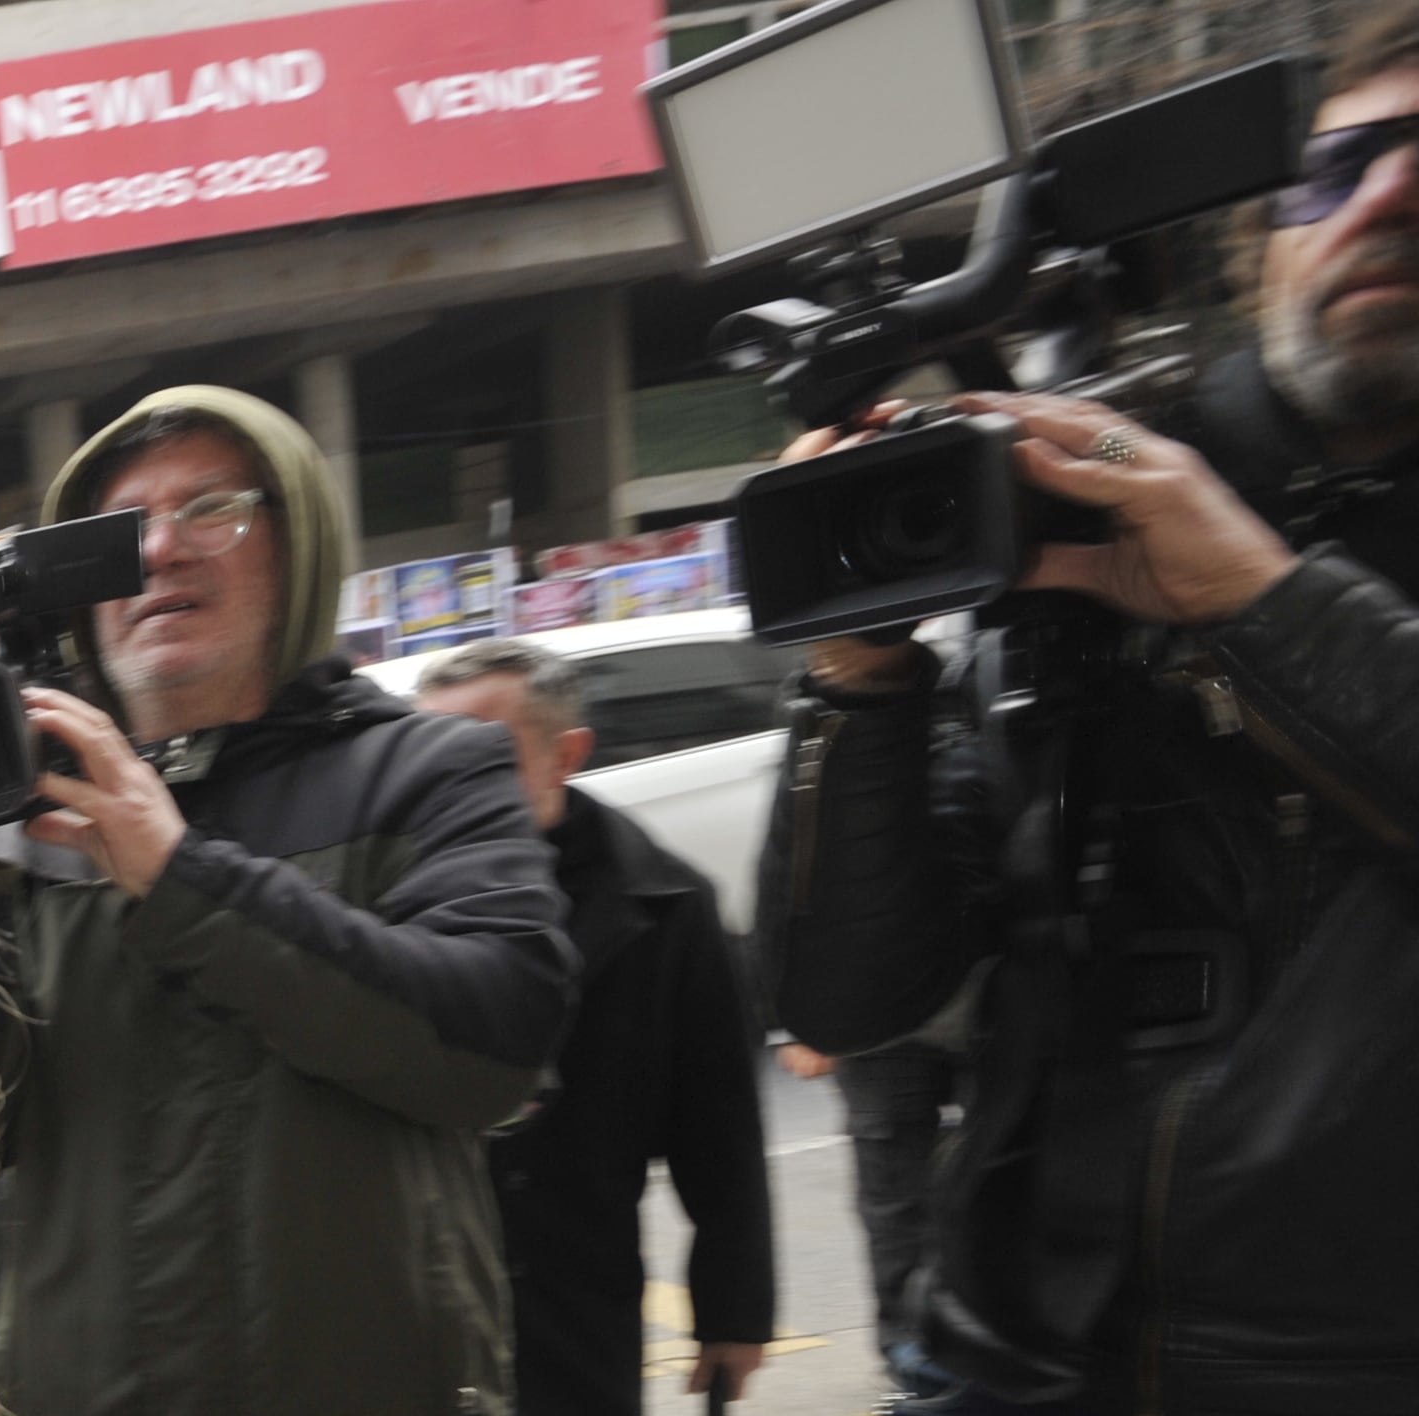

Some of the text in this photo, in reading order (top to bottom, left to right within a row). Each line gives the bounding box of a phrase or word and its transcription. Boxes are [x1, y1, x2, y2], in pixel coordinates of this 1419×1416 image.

[393, 55, 603, 126] VENDE
[7, 188, 59, 230] 11
[830, 321, 883, 344] SONY
